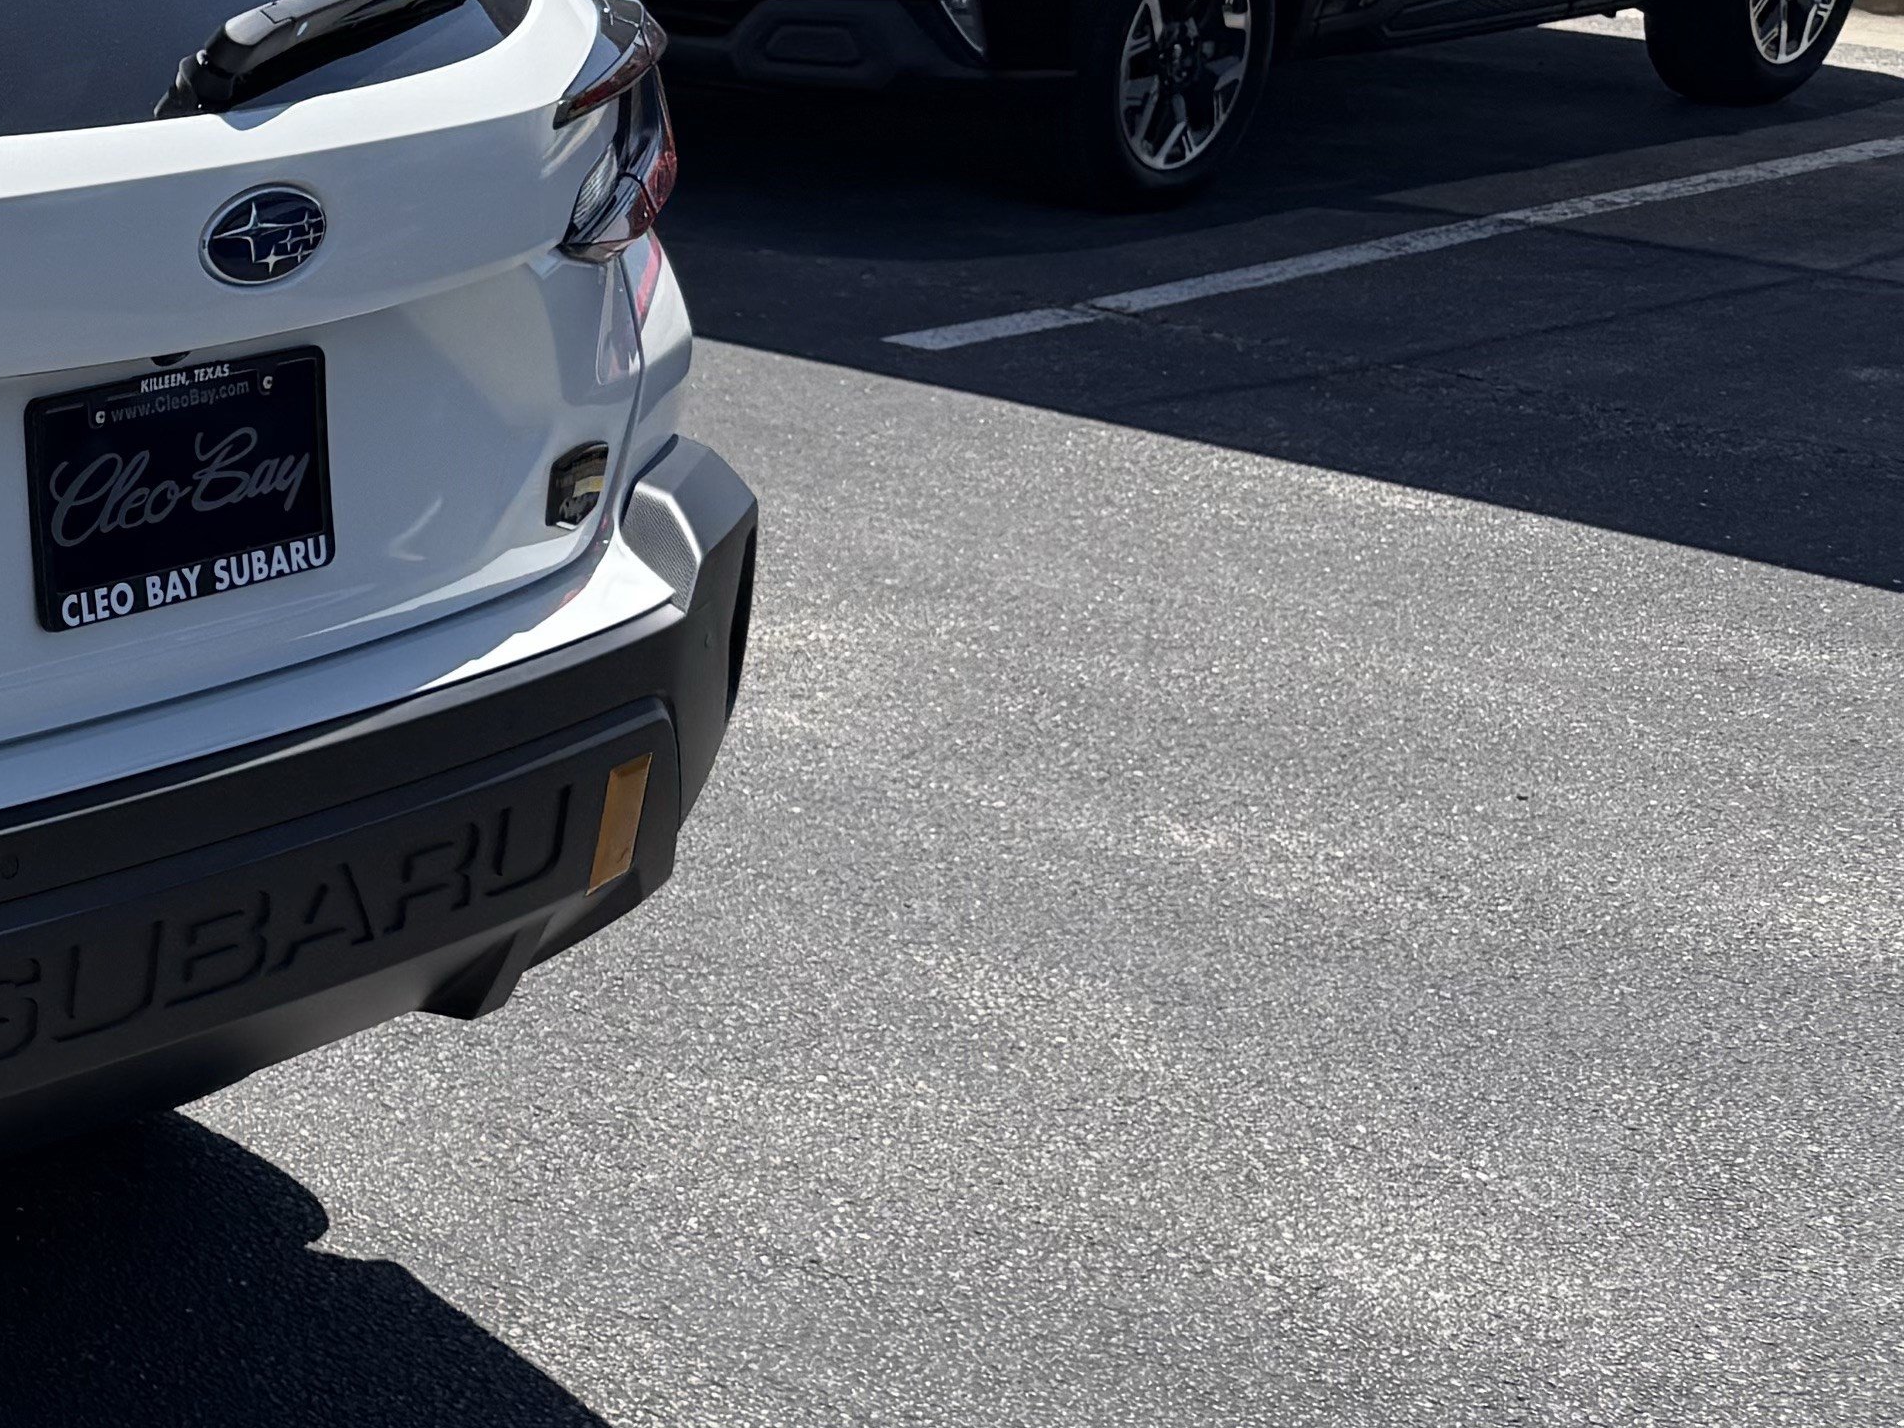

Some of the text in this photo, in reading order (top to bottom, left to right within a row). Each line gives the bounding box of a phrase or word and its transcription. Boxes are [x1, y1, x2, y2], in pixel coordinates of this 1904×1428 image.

[111, 380, 250, 422] www.CleoBay.com
[140, 363, 230, 393] KILLEEN, TEXAS
[49, 426, 310, 548] Cleo Bay
[61, 534, 328, 627] CLEO BAY SUBARU
